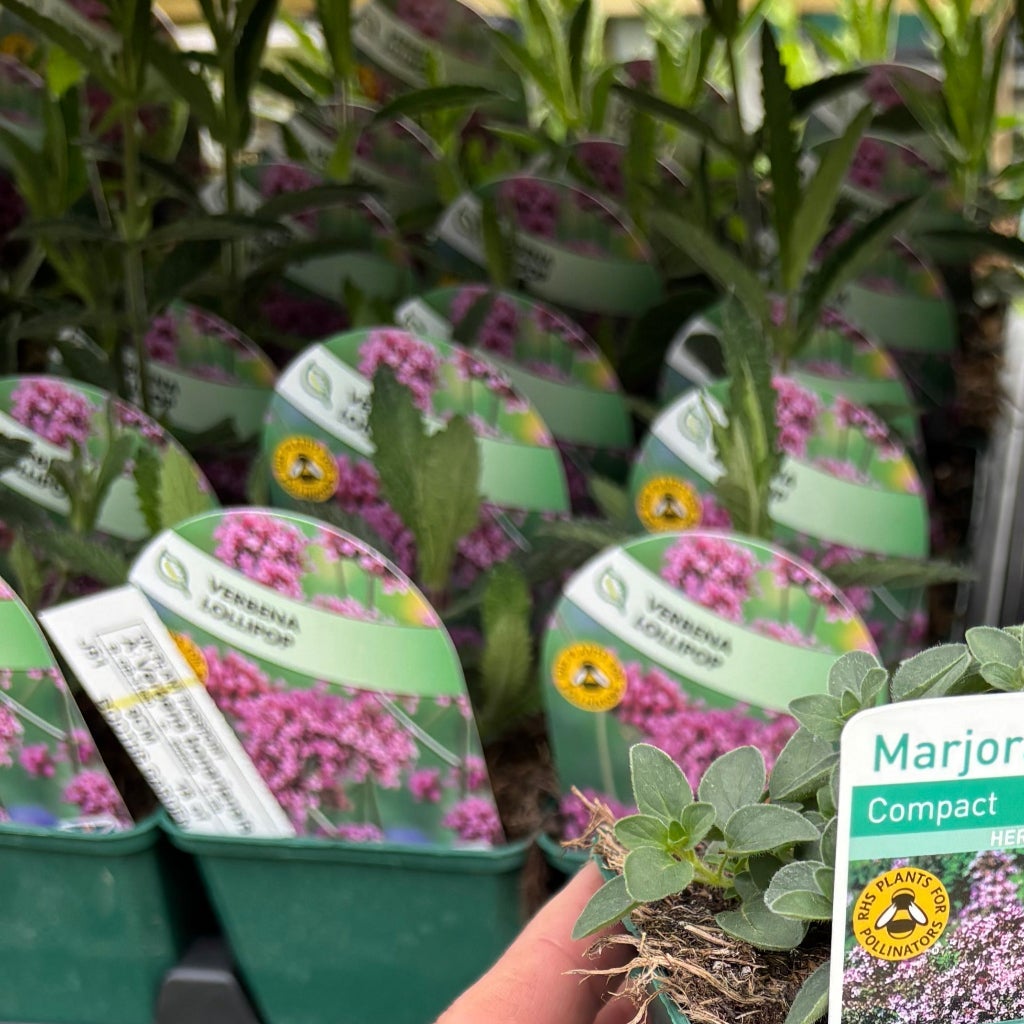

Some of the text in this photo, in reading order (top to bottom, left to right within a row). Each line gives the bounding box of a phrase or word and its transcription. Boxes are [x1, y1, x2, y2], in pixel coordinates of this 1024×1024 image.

[200, 597, 295, 649] LOLLIPOP
[208, 576, 301, 631] VERBENA
[646, 595, 733, 651] VERBENA
[634, 615, 725, 670] LOLLIPOP
[867, 792, 998, 826] Compact
[857, 871, 947, 921] RHS PLANTS FOR
[859, 920, 943, 957] POLLINATORS
